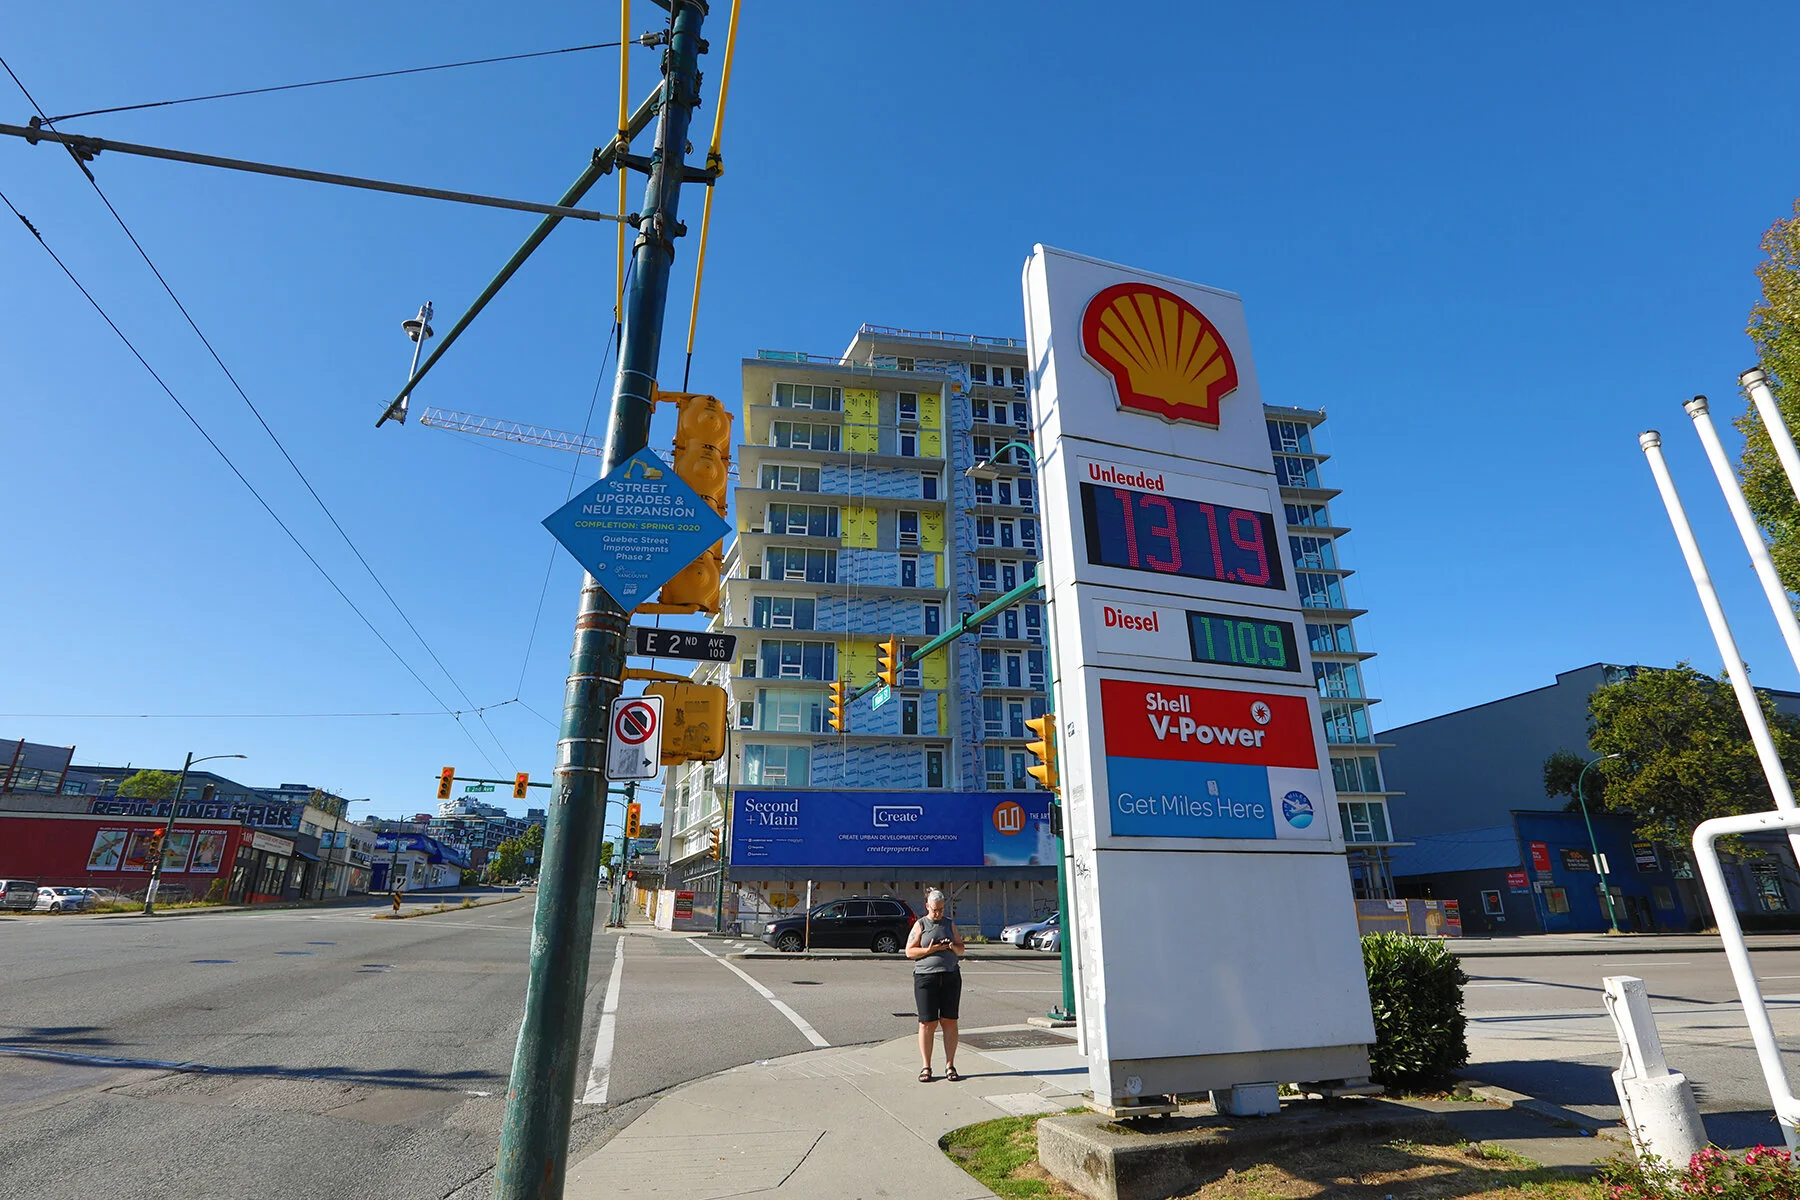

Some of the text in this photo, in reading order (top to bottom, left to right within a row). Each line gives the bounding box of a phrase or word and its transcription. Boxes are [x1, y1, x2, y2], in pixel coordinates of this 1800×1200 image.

[1088, 463, 1165, 492] Unleaded
[616, 483, 668, 494] STREET
[596, 494, 684, 506] UPGRADES &
[582, 504, 694, 518] NEU EXPANSION
[574, 520, 700, 532] COMPLETION: SPRING 2020
[602, 535, 668, 544] Quebec Street
[1114, 488, 1270, 586] 131.9
[603, 544, 668, 553] Improvements
[1104, 606, 1159, 632] Diesel
[646, 633, 658, 652] E
[708, 638, 724, 648] AVE
[1200, 617, 1286, 667] 110.9
[709, 649, 725, 658] 100
[1146, 692, 1191, 713] Shell
[1147, 714, 1266, 748] V-Power
[559, 794, 569, 805] 17
[745, 798, 798, 812] Second
[1118, 792, 1265, 819] Get Miles Here
[759, 812, 798, 826] Main
[878, 811, 918, 822] Create
